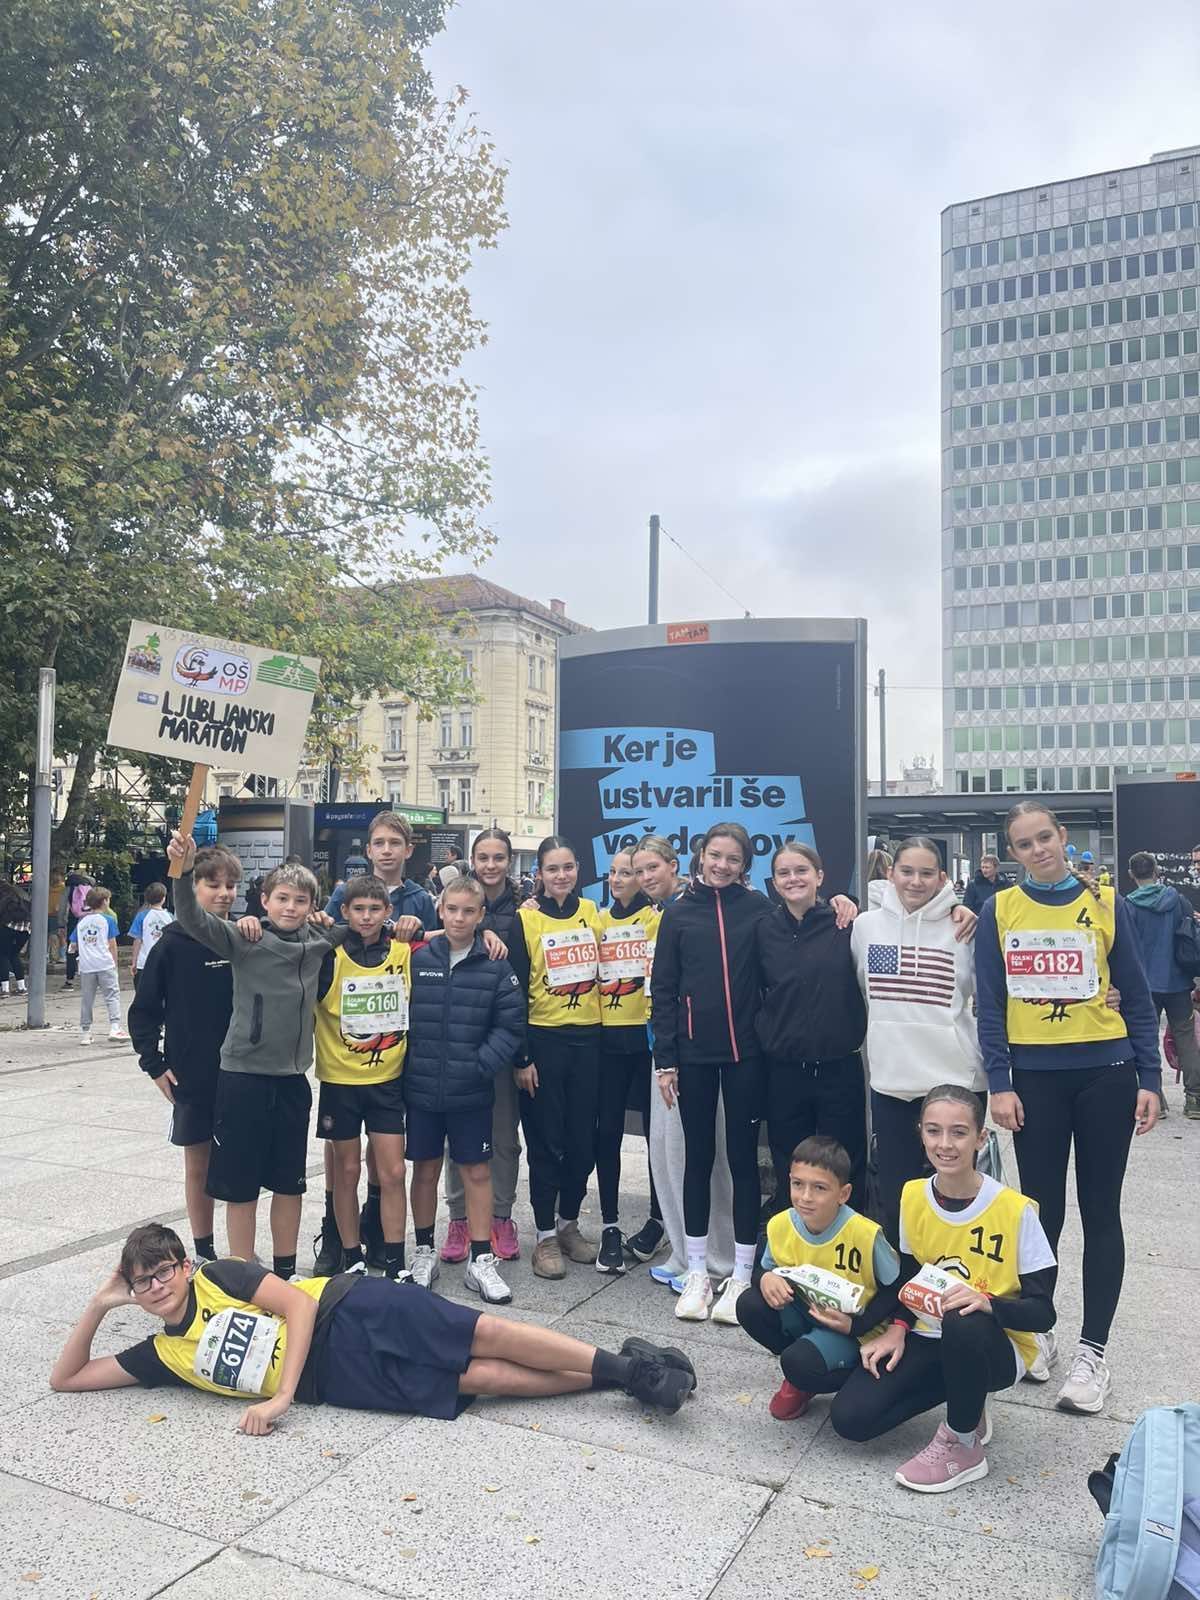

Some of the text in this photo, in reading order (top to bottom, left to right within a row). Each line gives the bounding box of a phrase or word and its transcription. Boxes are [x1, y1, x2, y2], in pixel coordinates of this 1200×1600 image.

[222, 660, 249, 679] OŠ
[219, 676, 246, 692] MP
[161, 691, 275, 736] LJUBLJANSKI
[158, 715, 249, 754] MARATON
[603, 732, 698, 767] Ker je
[603, 776, 787, 809] ustvaril še
[1076, 907, 1093, 927] 4
[567, 944, 595, 963] 6165
[616, 941, 646, 958] 6168
[1033, 952, 1080, 973] 6182
[366, 994, 397, 1012] 6160
[970, 1226, 1004, 1263] 11
[835, 1243, 862, 1274] 10
[221, 1317, 255, 1367] 6174
